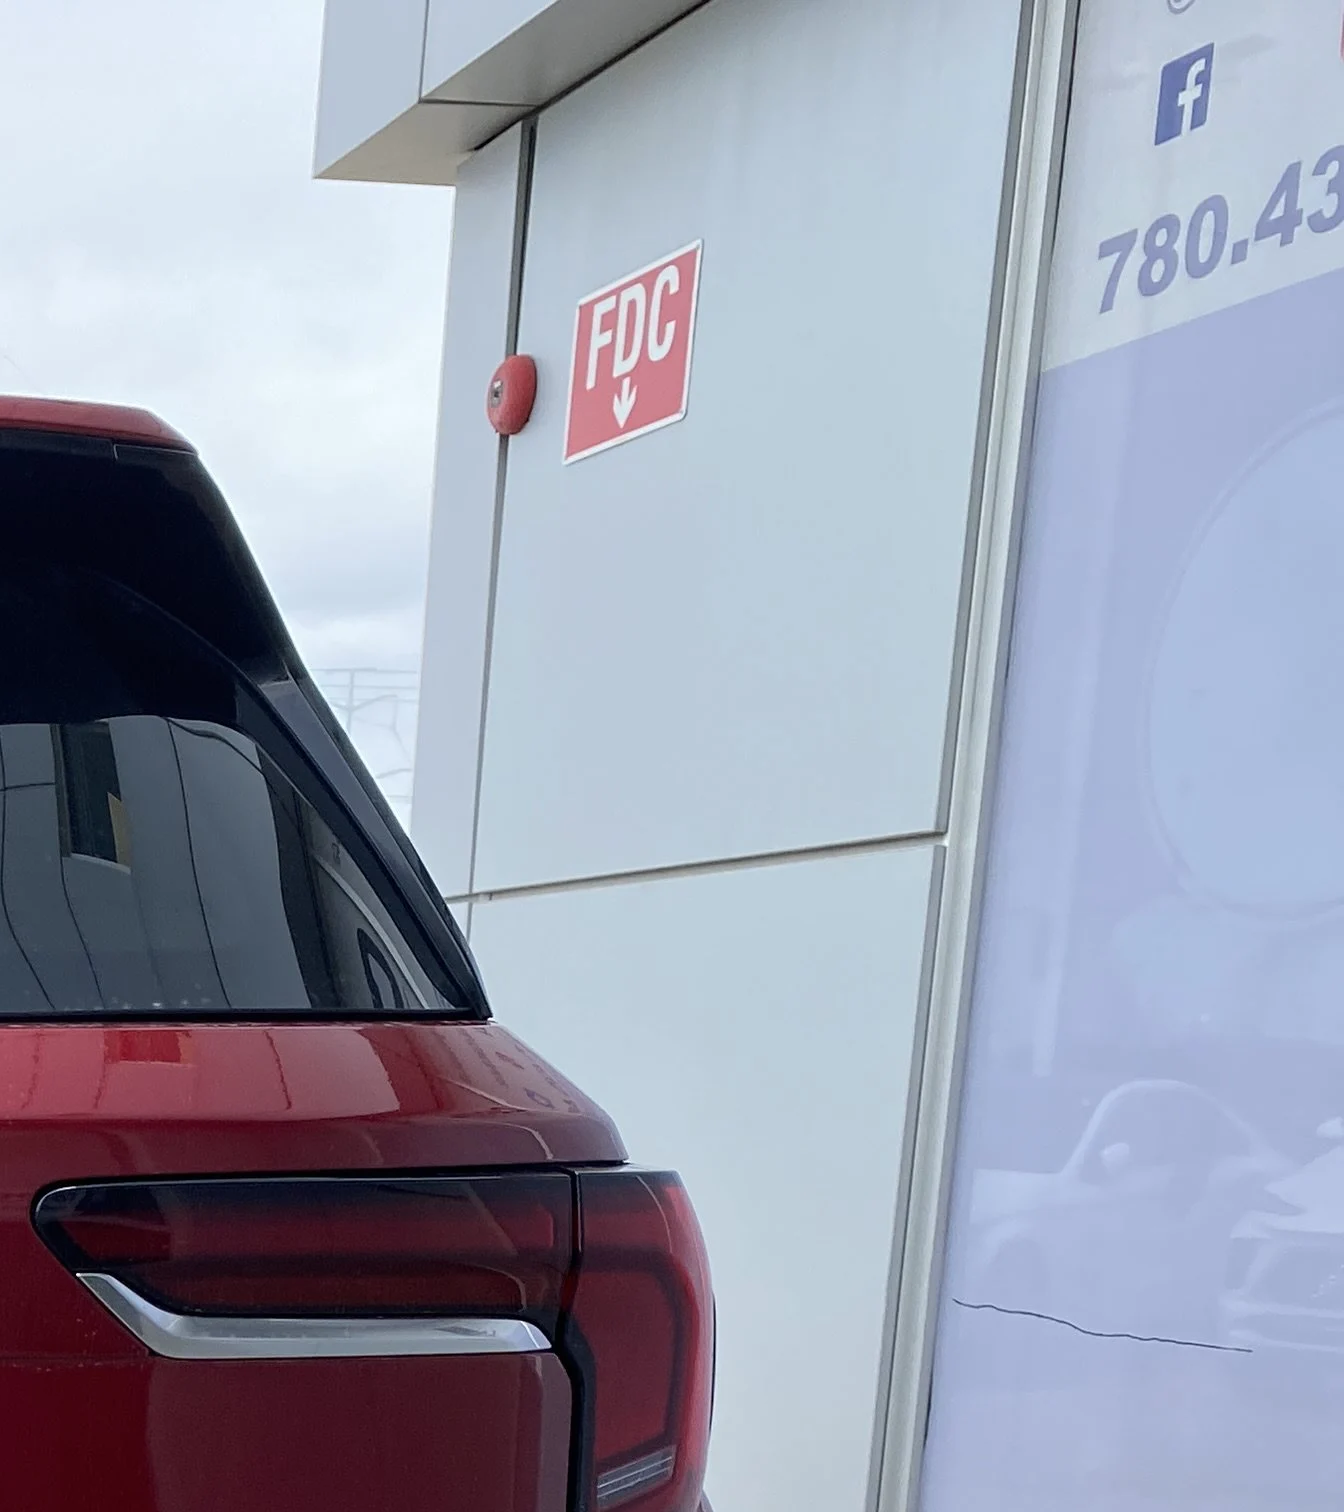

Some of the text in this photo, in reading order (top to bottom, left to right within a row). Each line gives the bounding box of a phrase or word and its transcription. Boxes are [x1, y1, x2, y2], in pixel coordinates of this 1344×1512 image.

[1177, 57, 1207, 140] f
[1097, 144, 1344, 314] 780.43
[586, 264, 680, 391] FDC
